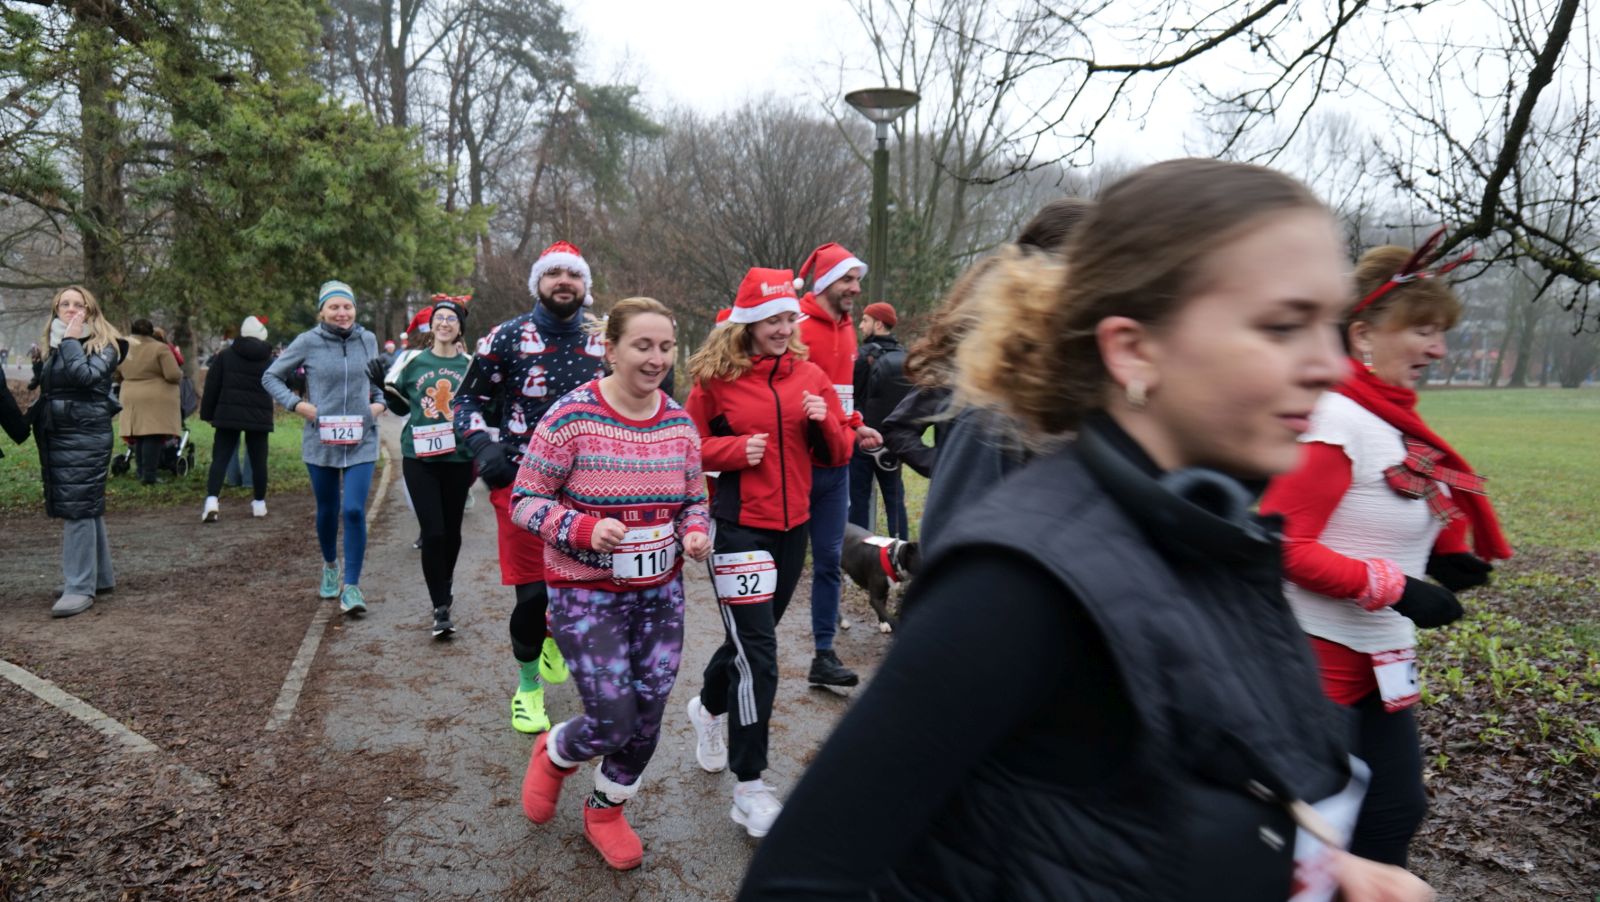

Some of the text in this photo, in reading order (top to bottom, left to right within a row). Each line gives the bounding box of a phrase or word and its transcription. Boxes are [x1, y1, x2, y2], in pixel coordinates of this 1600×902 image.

[332, 427, 354, 440] 124
[425, 437, 443, 451] 70
[623, 510, 641, 522] LOL
[656, 508, 670, 519] LOL
[634, 548, 667, 577] 110
[736, 573, 762, 596] 32
